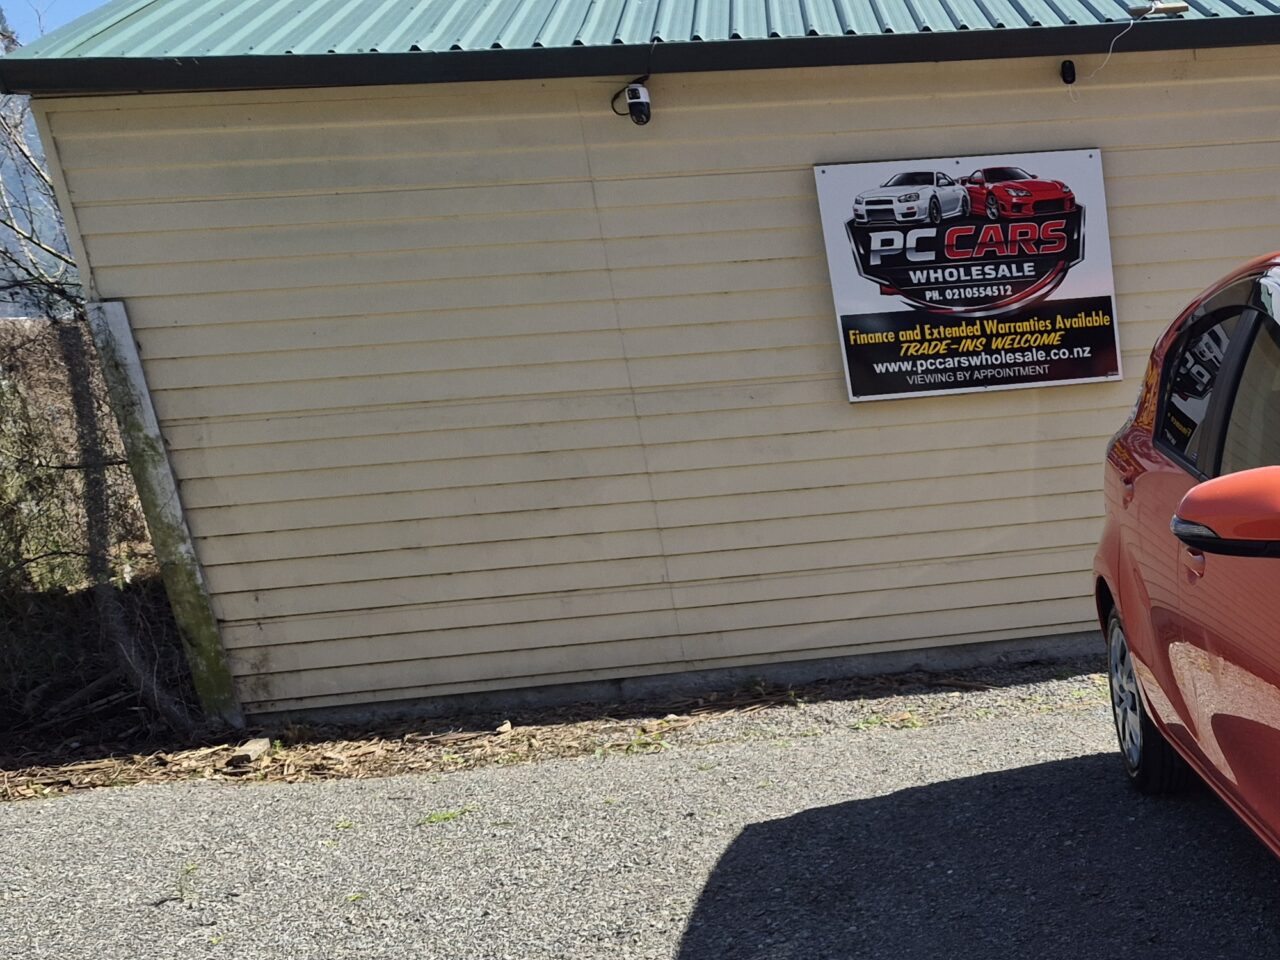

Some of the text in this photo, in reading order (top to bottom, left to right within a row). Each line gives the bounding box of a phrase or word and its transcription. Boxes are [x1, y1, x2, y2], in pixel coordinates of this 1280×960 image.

[869, 220, 1068, 266] PC CARS
[908, 262, 1036, 284] WHOLESALE
[925, 285, 1013, 301] PH. 0210554512
[849, 310, 1111, 345] Finance and Extended Warranties Available
[899, 331, 1065, 357] TRADE-INS WELCOME
[873, 344, 1092, 374] www.pccarswholesale.co.nz
[906, 364, 1050, 385] VIEWING BY APPOINTMENT
